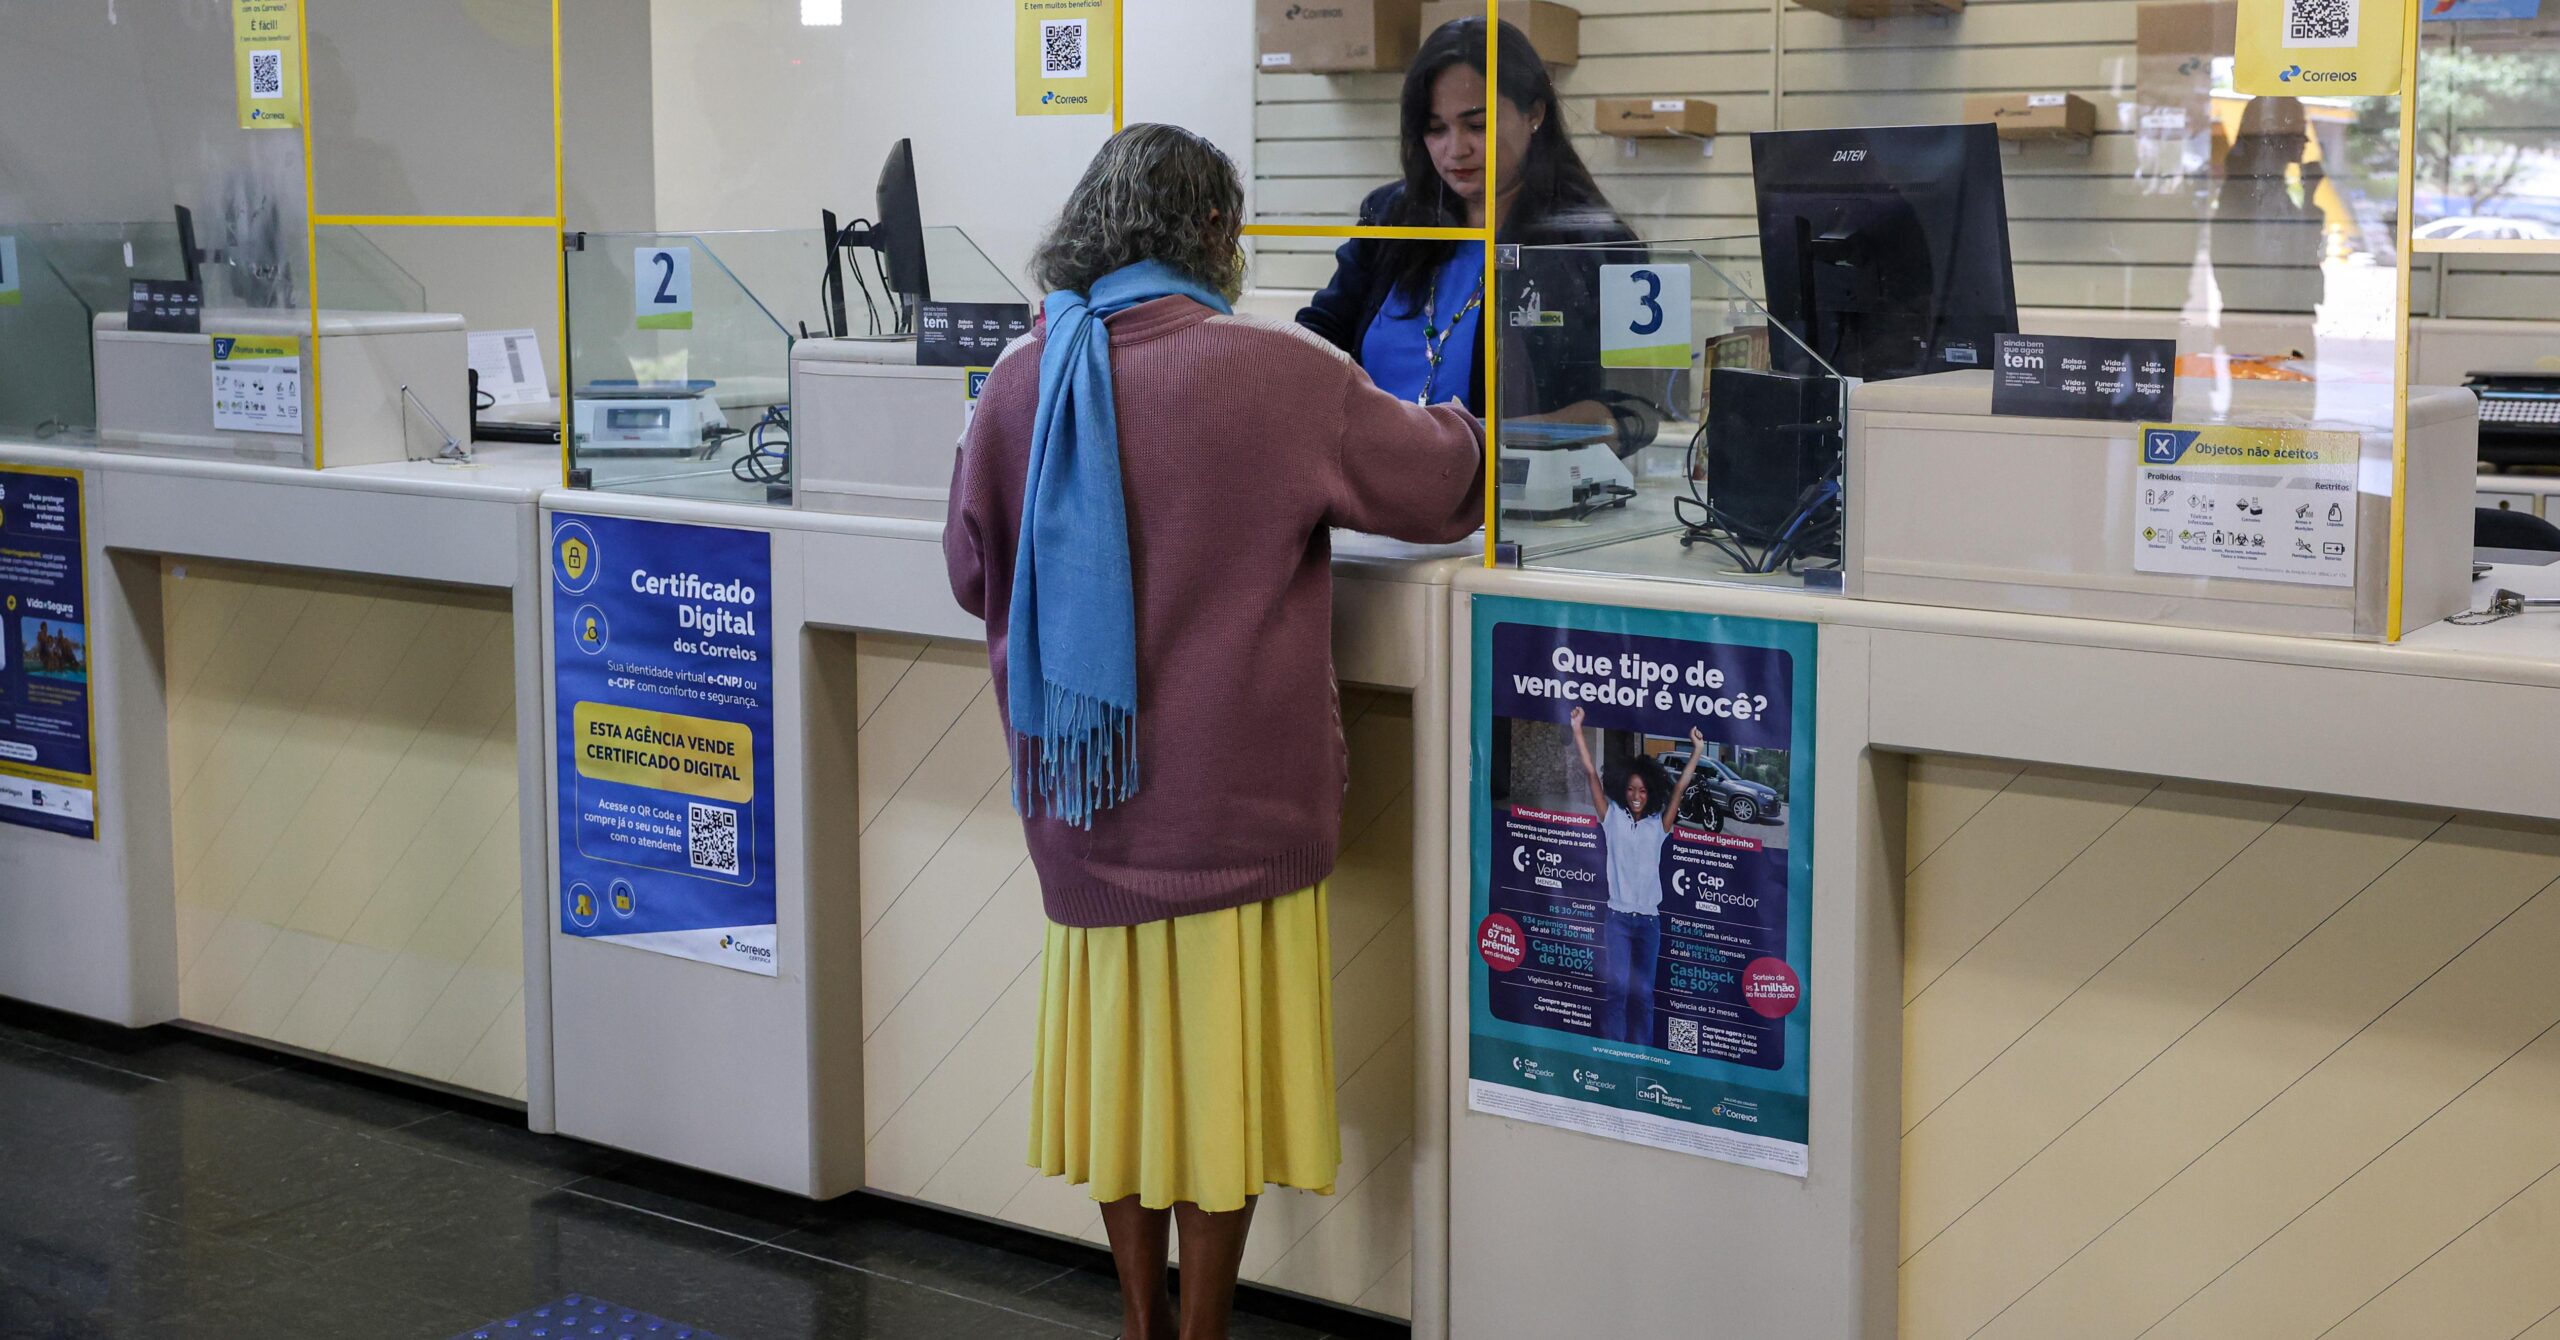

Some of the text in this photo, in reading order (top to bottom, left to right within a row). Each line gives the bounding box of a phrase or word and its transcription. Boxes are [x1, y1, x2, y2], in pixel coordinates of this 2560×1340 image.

[1045, 1, 1067, 9] muitos
[259, 20, 278, 30] fácil!
[2302, 70, 2357, 82] Correios
[1055, 95, 1088, 104] Correios
[1833, 150, 1867, 161] DATEN
[652, 252, 677, 304] 2
[1629, 270, 1663, 335] 3
[924, 317, 948, 328] tem
[2004, 347, 2044, 356] que agora
[2004, 354, 2044, 369] tem
[2101, 365, 2126, 373] Segura
[2141, 366, 2166, 374] Seguro
[2195, 443, 2318, 460] Objetos não aceitos
[2147, 472, 2181, 481] Proibidos
[2315, 483, 2349, 492] Restritos
[631, 569, 755, 604] Certificado
[679, 604, 756, 637] Digital
[674, 638, 757, 662] dos Correios
[608, 660, 757, 690] Sua identidade virtual e-CNPJ ou
[1552, 646, 1724, 689] Que tipo de
[608, 677, 758, 709] e-CPF com conforto e segurança.
[1513, 674, 1768, 721] vencedor é você?
[590, 721, 735, 756] ESTA AGÊNCIA VENDE
[586, 744, 740, 781] CERTIFICADO DIGITAL
[598, 798, 682, 822] Acesse o QR Code e
[1517, 808, 1590, 825] Vencedor poupador
[584, 813, 682, 838] compre já o seu ou fale
[1507, 821, 1537, 832] Economiza
[1548, 828, 1580, 839] pouquinho
[1582, 832, 1597, 840] todo
[610, 832, 682, 853] com o atendente
[1537, 835, 1558, 844] chance
[1579, 840, 1597, 848] sorte.
[1679, 830, 1754, 848] Vencedor ligeirinho
[1536, 848, 1562, 866] Cap
[1673, 845, 1688, 854] Paga
[1704, 850, 1720, 858] única
[1673, 855, 1700, 864] concorre
[1536, 863, 1597, 882] Vencedor
[1698, 872, 1725, 890] Cap
[1697, 886, 1759, 908] Vencedor
[1549, 905, 1559, 914] R$
[1572, 902, 1596, 911] Guarde
[1537, 918, 1595, 933] prêmios mensais
[1671, 917, 1715, 931] Pague apenas
[1488, 928, 1515, 944] 67 mil
[1671, 925, 1681, 933] R$
[1705, 932, 1720, 940] uma
[1721, 934, 1738, 943] única
[735, 941, 771, 957] Correios
[1482, 938, 1520, 956] prêmios
[1532, 940, 1594, 960] Cashback
[1680, 950, 1690, 958] até
[1691, 951, 1702, 959] R$
[1686, 943, 1746, 959] prêmios mensais
[1539, 953, 1593, 972] de 100%
[1670, 963, 1735, 984] Cashback
[1528, 976, 1554, 986] Vigência
[1554, 978, 1563, 987] de
[1572, 984, 1594, 992] meses.
[1670, 976, 1687, 988] de
[1690, 978, 1719, 994] 50%
[1760, 983, 1794, 992] milhão
[1670, 1000, 1697, 1011] Vigência
[1698, 1003, 1707, 1012] de
[1717, 1009, 1739, 1018] meses.
[1702, 1025, 1725, 1034] Compre
[1524, 1059, 1538, 1068] Cap
[1592, 1046, 1671, 1065] www.capvencedor.com.br
[1525, 1066, 1555, 1077] Vencedor
[1586, 1070, 1599, 1080] Cap
[1586, 1078, 1616, 1090] Vencedor
[1638, 1090, 1655, 1100] CNP
[1726, 1109, 1758, 1122] Correios
